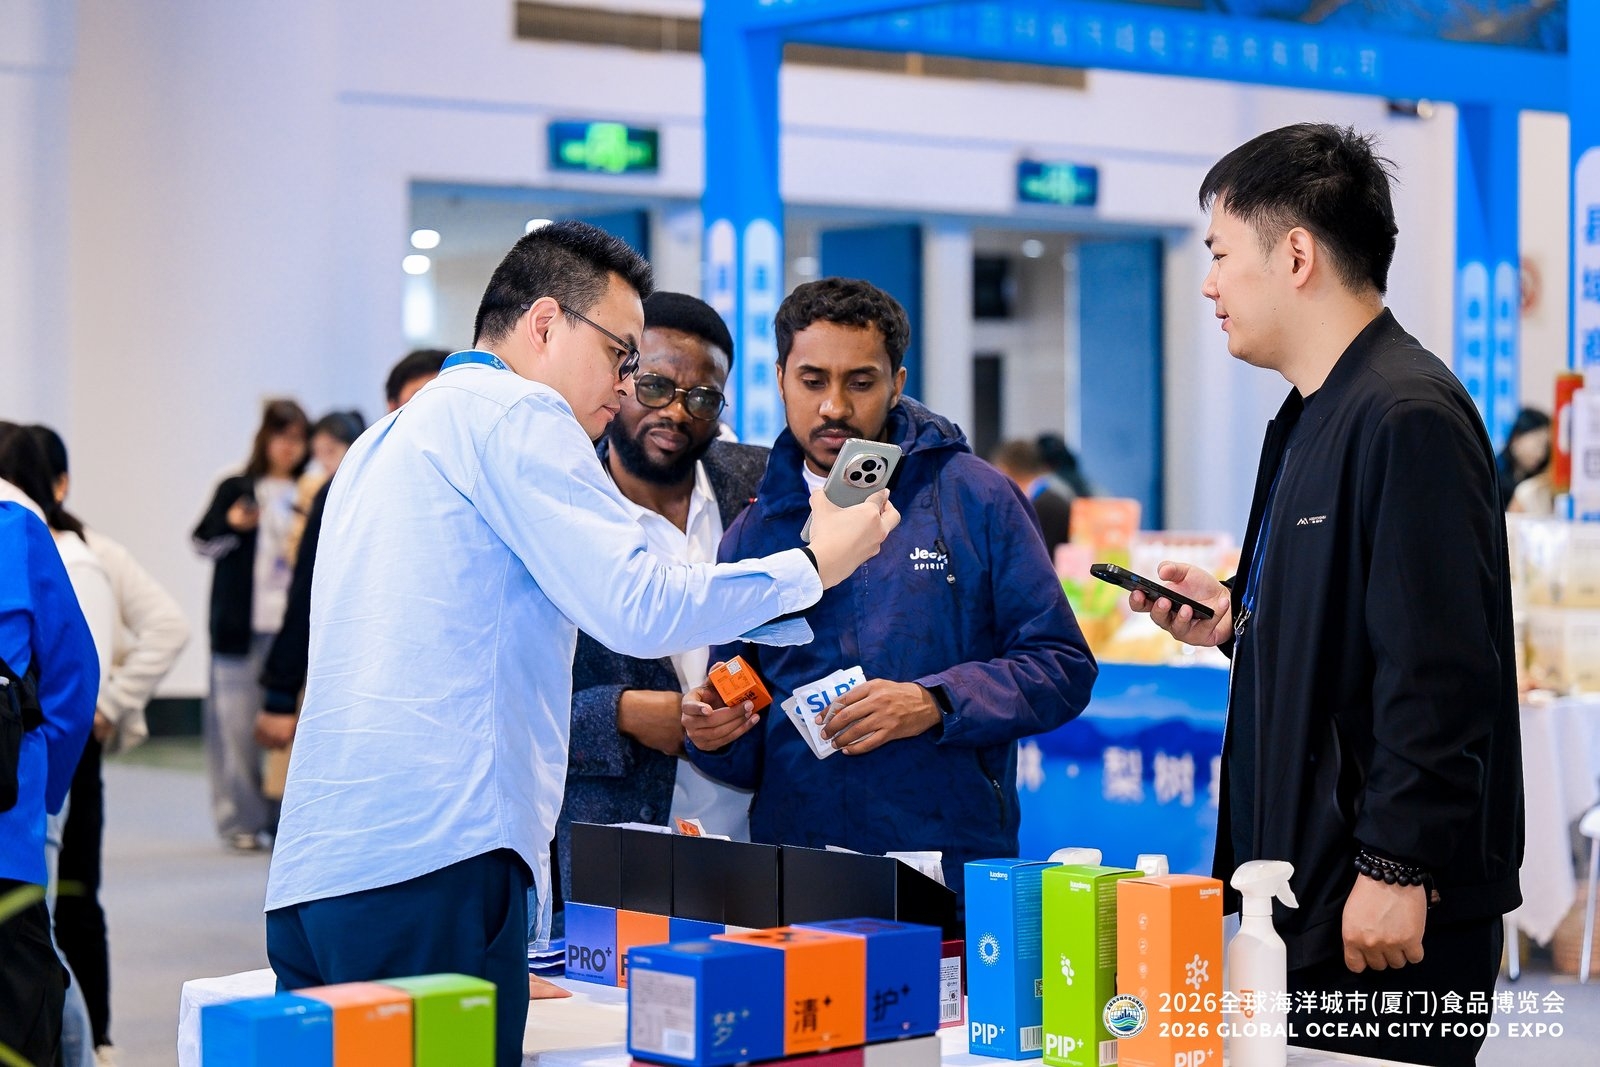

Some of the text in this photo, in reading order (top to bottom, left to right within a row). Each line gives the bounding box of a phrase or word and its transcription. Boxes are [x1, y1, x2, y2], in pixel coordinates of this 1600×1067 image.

[568, 944, 612, 972] PRO+
[971, 1021, 1006, 1045] PIP+
[1045, 1033, 1084, 1058] PIP+
